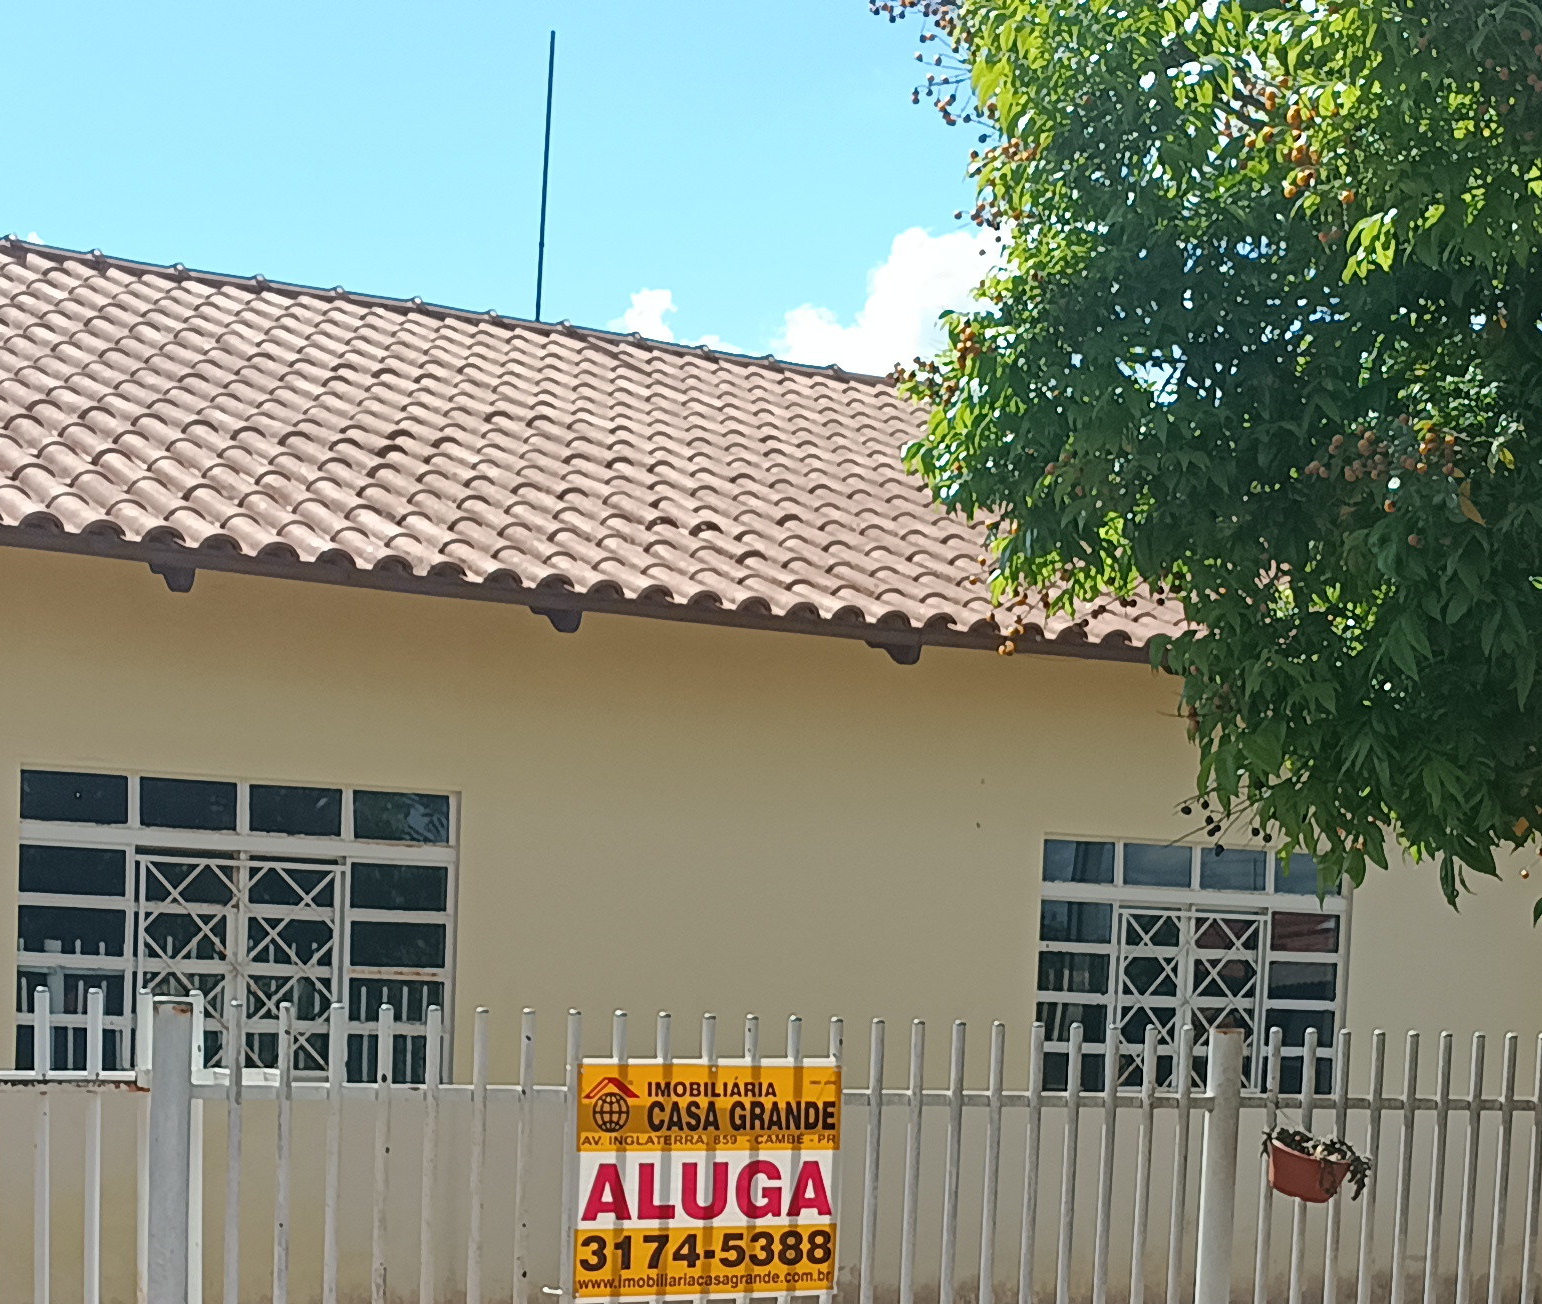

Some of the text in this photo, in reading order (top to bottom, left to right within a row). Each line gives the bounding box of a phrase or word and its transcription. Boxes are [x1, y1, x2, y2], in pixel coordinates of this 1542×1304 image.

[646, 1076, 778, 1099] IMOBILIÁRIA
[646, 1100, 837, 1133] CASA GRANDE
[581, 1135, 604, 1147] AV.
[713, 1133, 738, 1145] 859
[754, 1132, 805, 1145] CAMBÉ
[817, 1133, 836, 1144] PR
[580, 1159, 833, 1221] ALUGA
[578, 1229, 833, 1272] 3174-5388
